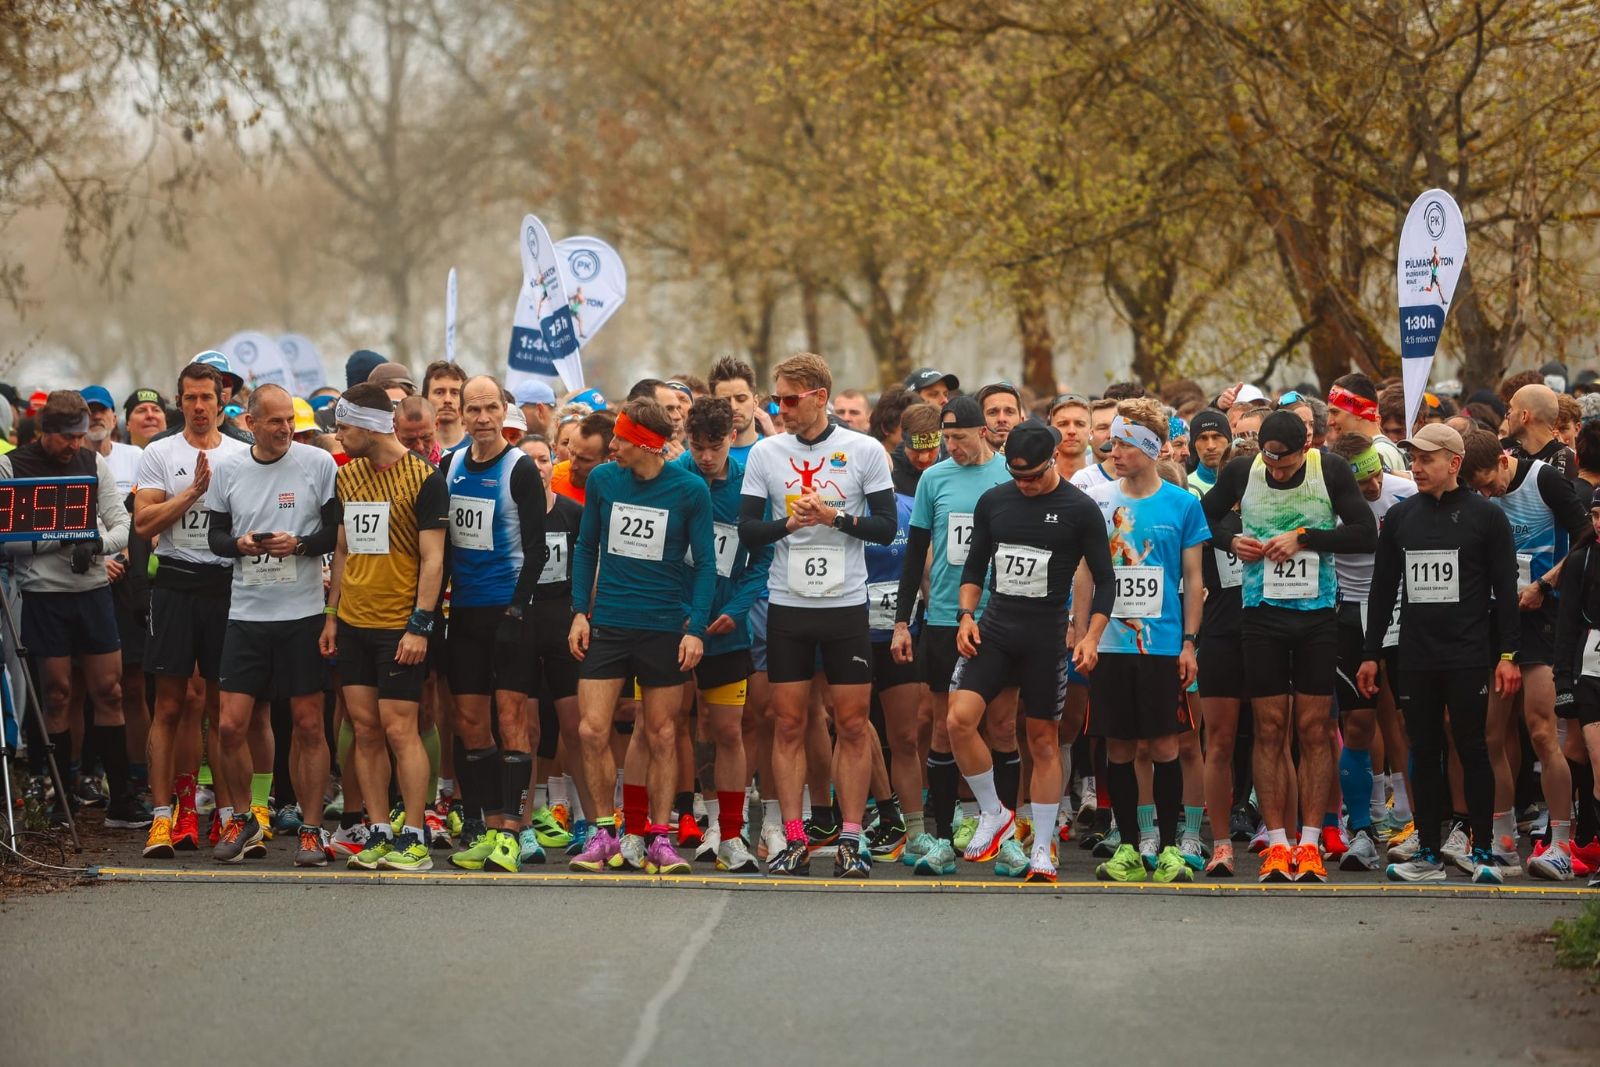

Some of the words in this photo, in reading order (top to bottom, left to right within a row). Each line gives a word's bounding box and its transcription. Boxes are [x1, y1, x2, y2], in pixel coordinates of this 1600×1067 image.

[577, 261, 591, 271] PK
[586, 298, 604, 309] TON
[824, 500, 846, 508] NISHER
[353, 513, 380, 533] 157
[455, 508, 483, 530] 801
[620, 516, 655, 539] 225
[42, 531, 95, 540] ONLINETIMING
[804, 557, 828, 577] 63
[1005, 555, 1038, 577] 757
[1273, 559, 1307, 578] 421
[1411, 562, 1453, 582] 1119
[1116, 578, 1158, 598] 1359
